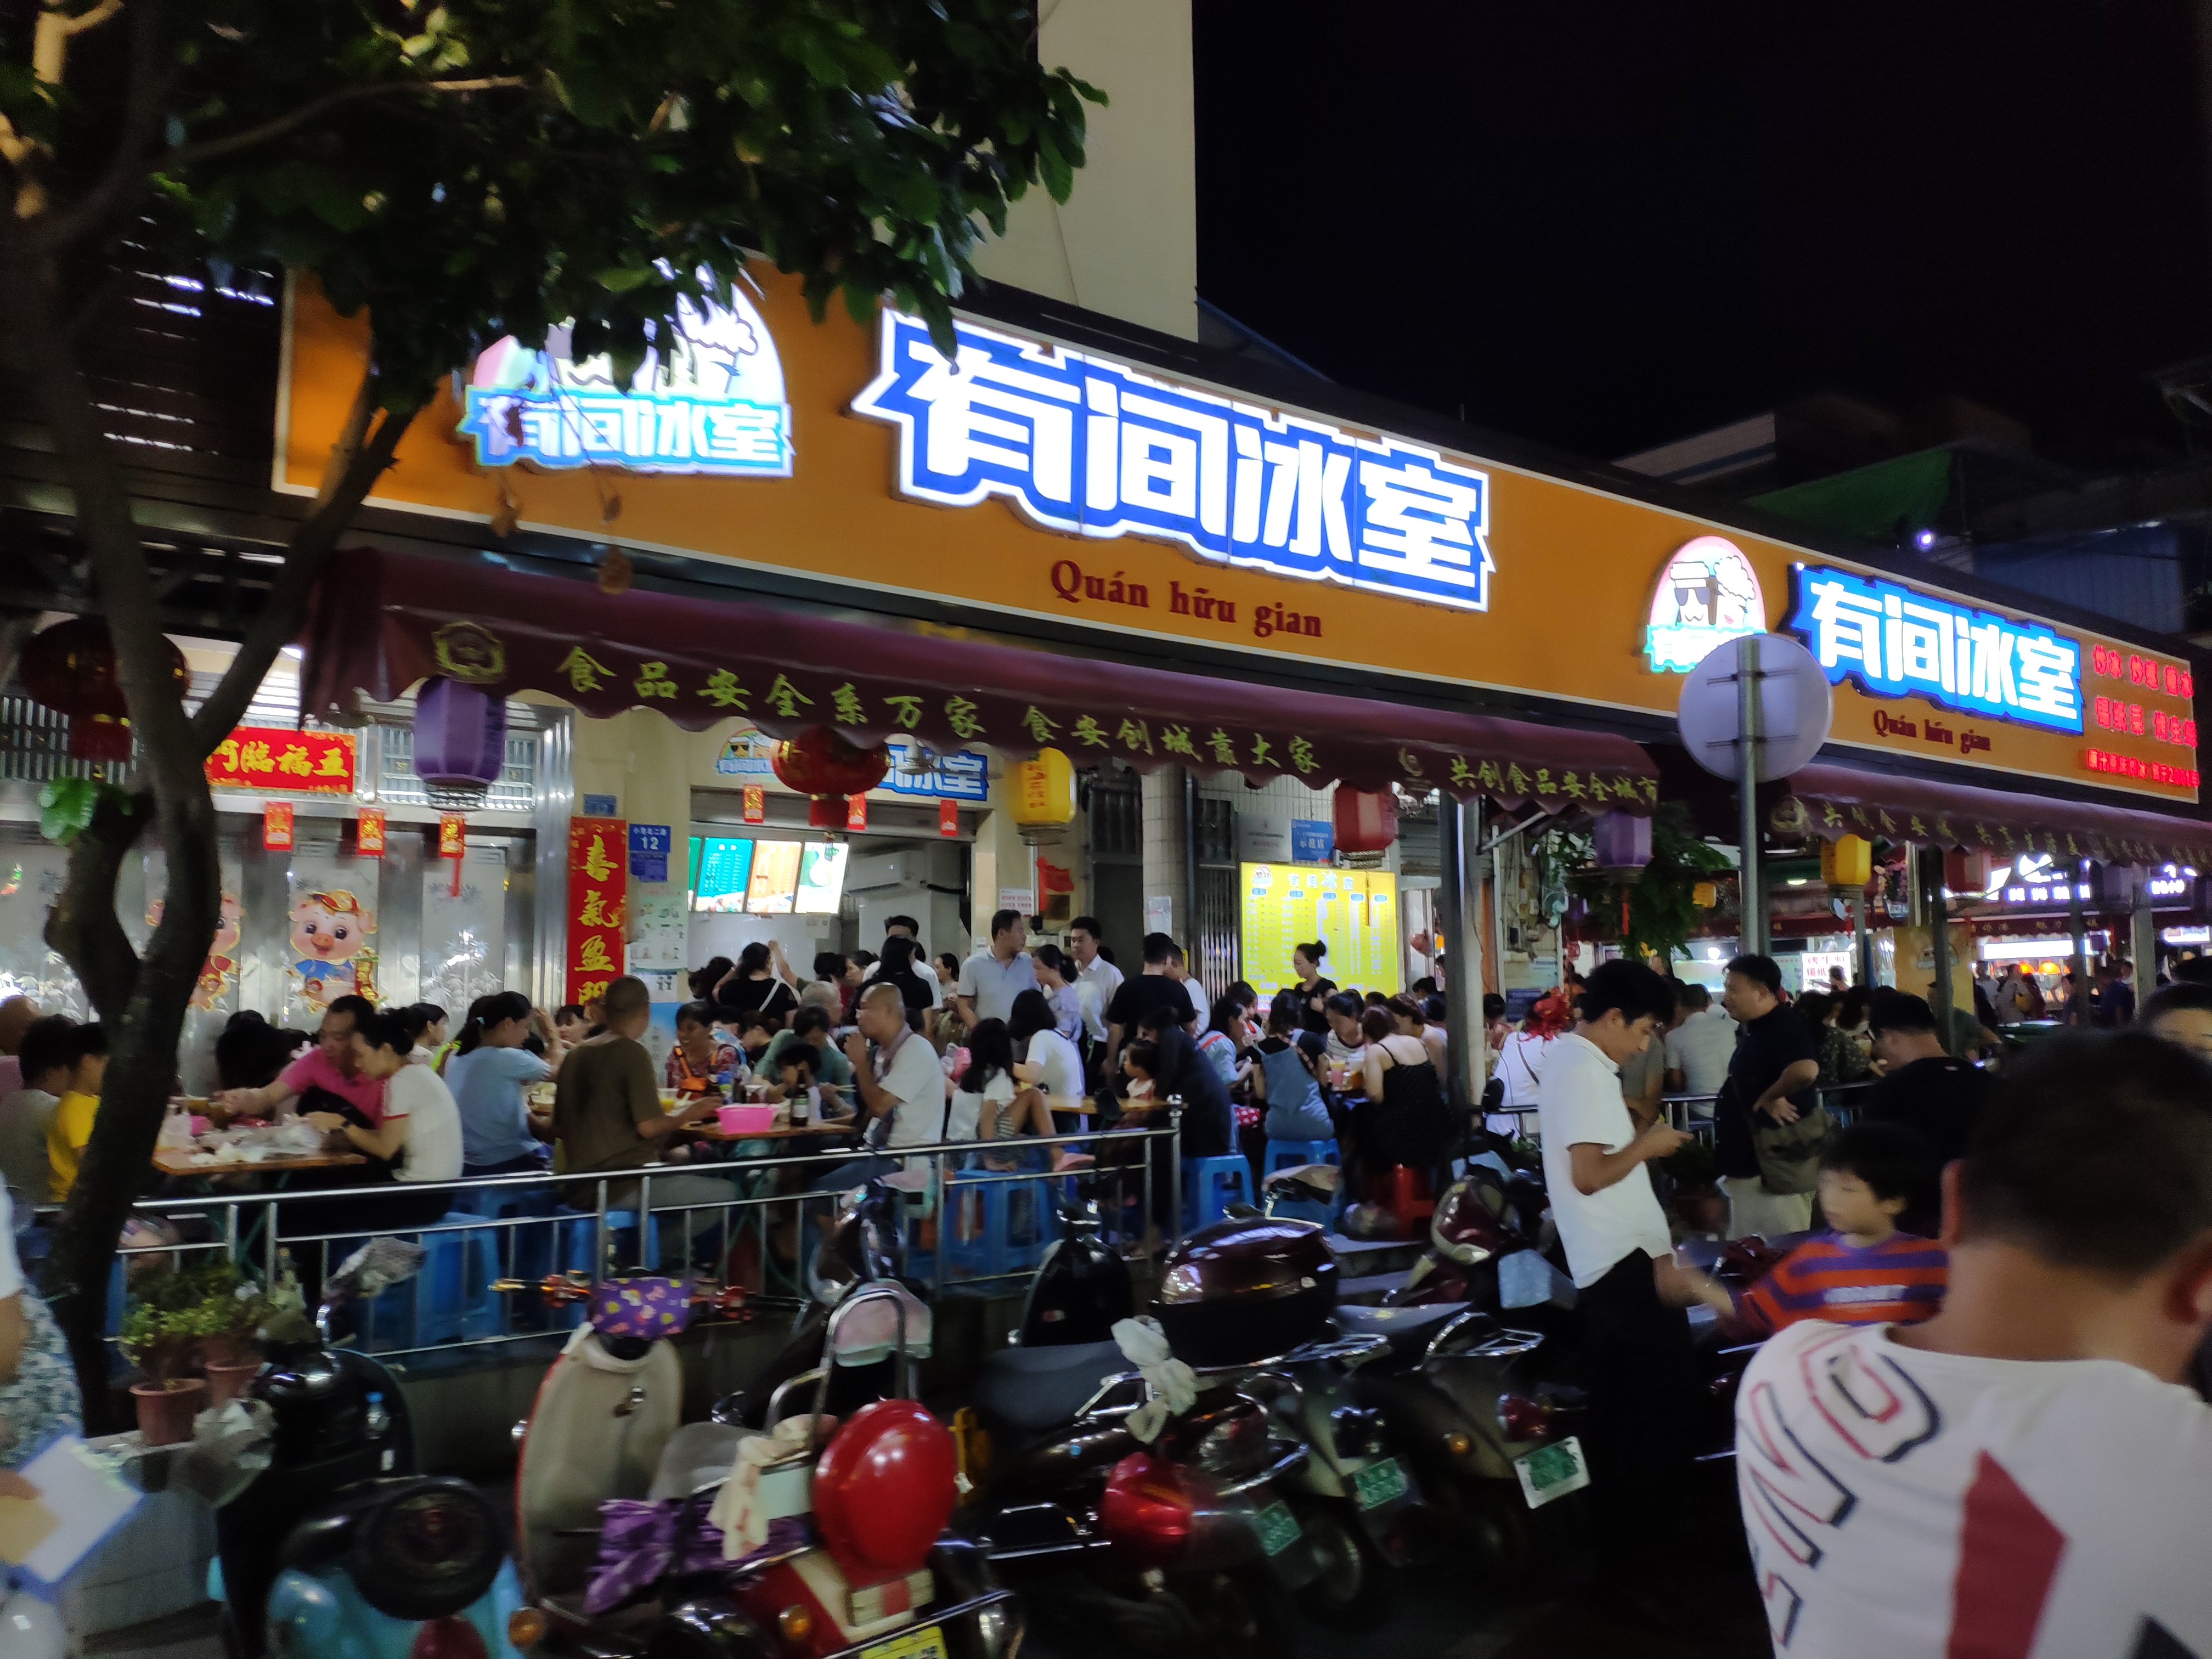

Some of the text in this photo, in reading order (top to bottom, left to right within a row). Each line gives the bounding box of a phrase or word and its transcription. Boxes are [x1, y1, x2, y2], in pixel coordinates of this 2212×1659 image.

[906, 339, 1478, 588] 有间冰室
[1051, 560, 1150, 607] Quán
[1254, 602, 1322, 637] gian
[556, 645, 986, 738] 食品安全系万家
[1809, 579, 2078, 720] 有间冰室
[1022, 704, 1321, 774] 食安创城靠大家
[641, 836, 659, 850] 12
